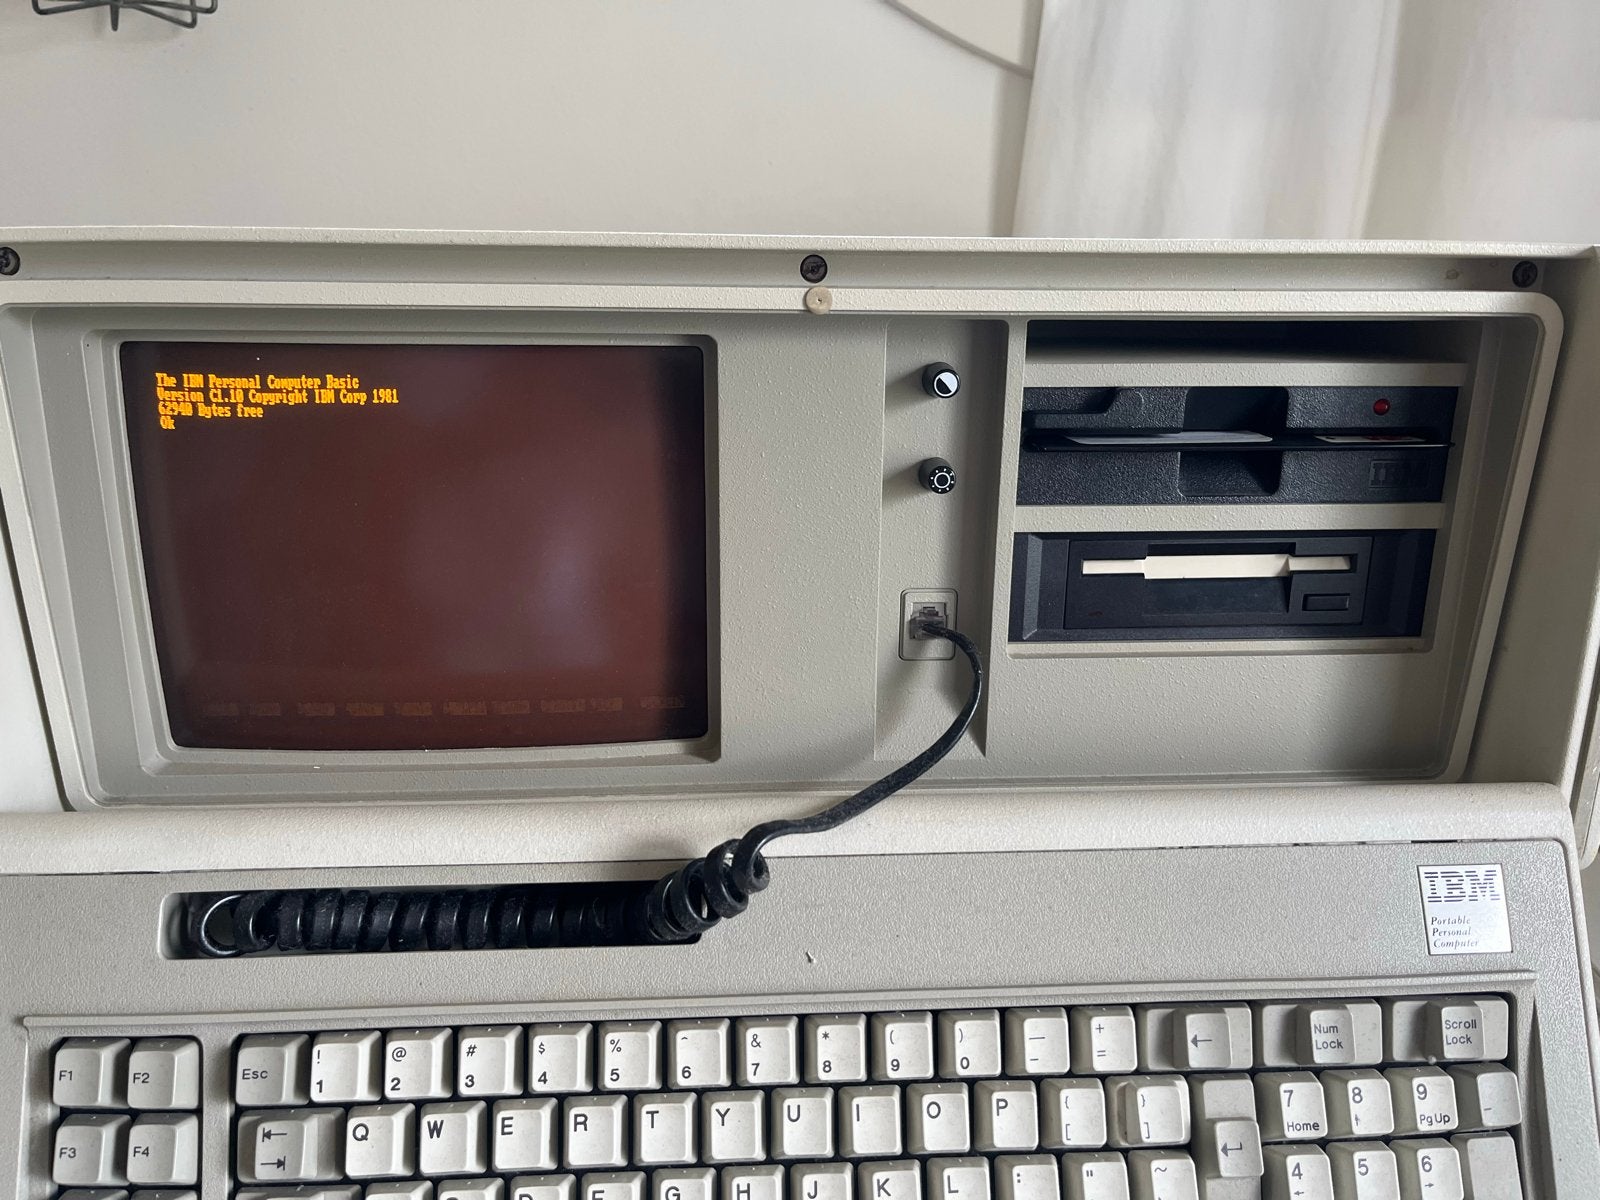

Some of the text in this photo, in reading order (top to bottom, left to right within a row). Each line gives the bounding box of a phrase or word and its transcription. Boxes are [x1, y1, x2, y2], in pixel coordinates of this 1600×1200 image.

[156, 372, 360, 390] The IBM Personal Computer Basic
[157, 387, 204, 402] Version
[249, 389, 308, 406] Copyright
[314, 389, 335, 404] IBM
[340, 389, 367, 406] Corp
[372, 389, 399, 404] 1981
[197, 402, 231, 418] Bytes
[237, 403, 263, 418] free
[160, 415, 176, 430] Ok
[1424, 870, 1500, 903] IBM
[1431, 915, 1471, 926] Portable
[1432, 927, 1472, 937] Personal
[1433, 939, 1480, 950] Computer
[1095, 1023, 1105, 1034] +
[1314, 1023, 1339, 1034] Num
[1445, 1019, 1477, 1030] Scroll
[750, 1033, 762, 1049] &
[889, 1029, 895, 1045] (
[958, 1027, 964, 1044] )
[1445, 1033, 1473, 1046] Lock
[465, 1044, 478, 1057] #
[538, 1042, 546, 1054] $
[609, 1038, 622, 1053] %
[1315, 1038, 1344, 1050] Lock
[316, 1050, 321, 1064] !
[391, 1046, 407, 1063] @
[1096, 1049, 1107, 1058] =
[751, 1062, 761, 1077] 7
[822, 1059, 832, 1074] 8
[890, 1058, 901, 1072] 9
[960, 1056, 970, 1070] 0
[58, 1069, 73, 1081] F1
[132, 1072, 150, 1084] F2
[241, 1068, 269, 1080] Esc
[537, 1070, 549, 1085] 4
[609, 1068, 620, 1082] 5
[681, 1065, 692, 1080] 6
[316, 1079, 323, 1094] 1
[390, 1076, 401, 1092] 2
[464, 1075, 475, 1088] 3
[1283, 1089, 1294, 1108] 7
[1351, 1086, 1364, 1104] 8
[1416, 1084, 1428, 1100] 9
[995, 1098, 1009, 1117] P
[1064, 1095, 1070, 1110] {
[1140, 1094, 1146, 1108] }
[715, 1107, 731, 1127] Y
[787, 1104, 801, 1123] U
[855, 1103, 861, 1122] I
[926, 1101, 942, 1120] O
[501, 1117, 514, 1135] E
[573, 1113, 589, 1133] R
[645, 1110, 660, 1129] T
[1287, 1121, 1320, 1132] Home
[352, 1123, 369, 1142] Q
[427, 1120, 444, 1138] W
[1065, 1124, 1071, 1140] [
[1143, 1123, 1150, 1139] ]
[59, 1146, 77, 1159] F3
[133, 1146, 150, 1158] F4
[1291, 1162, 1304, 1180] 4
[1357, 1158, 1369, 1177] 5
[1421, 1155, 1433, 1173] 6
[736, 1182, 751, 1200] H
[807, 1180, 818, 1200] J
[876, 1177, 892, 1198] K
[946, 1174, 959, 1194] L
[664, 1185, 681, 1200] G
